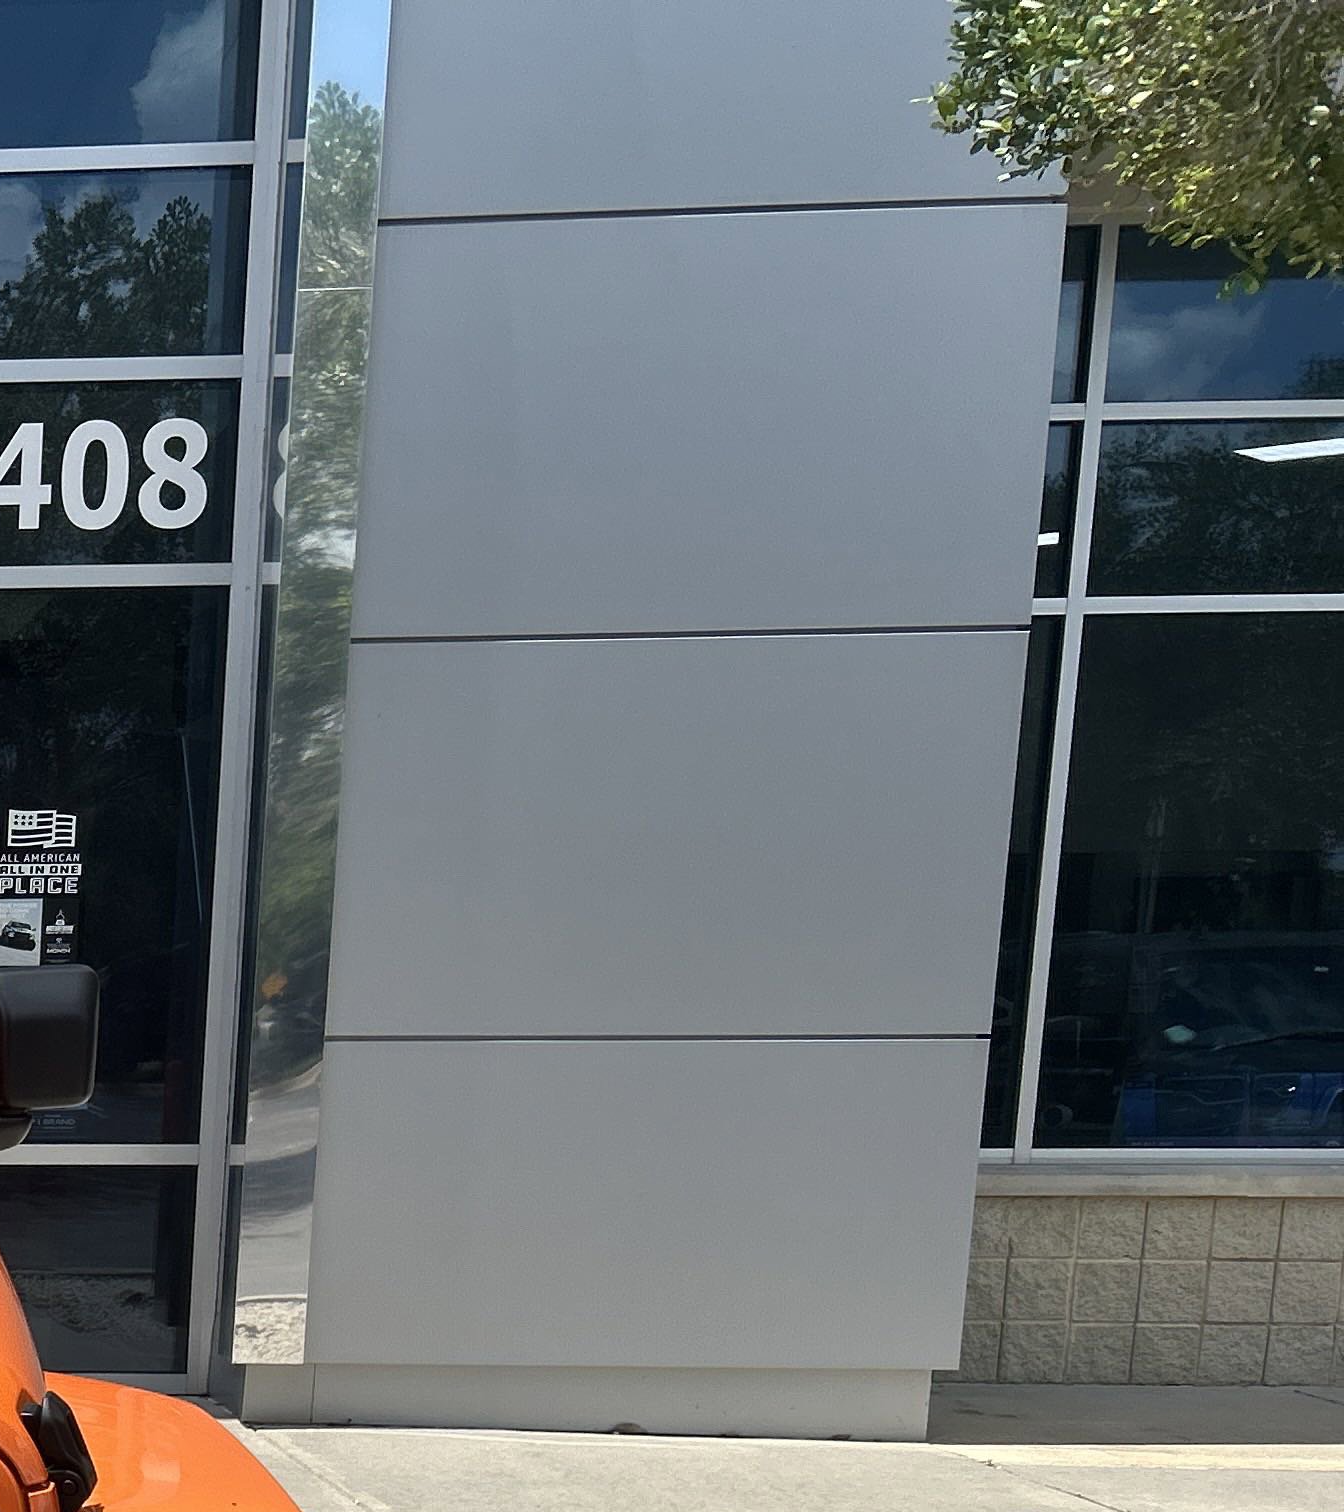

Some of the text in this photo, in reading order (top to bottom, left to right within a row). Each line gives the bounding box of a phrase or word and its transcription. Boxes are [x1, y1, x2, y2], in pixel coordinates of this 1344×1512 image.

[0, 853, 81, 863] ALL AMERICAN
[0, 865, 80, 875] ALL IN ONE
